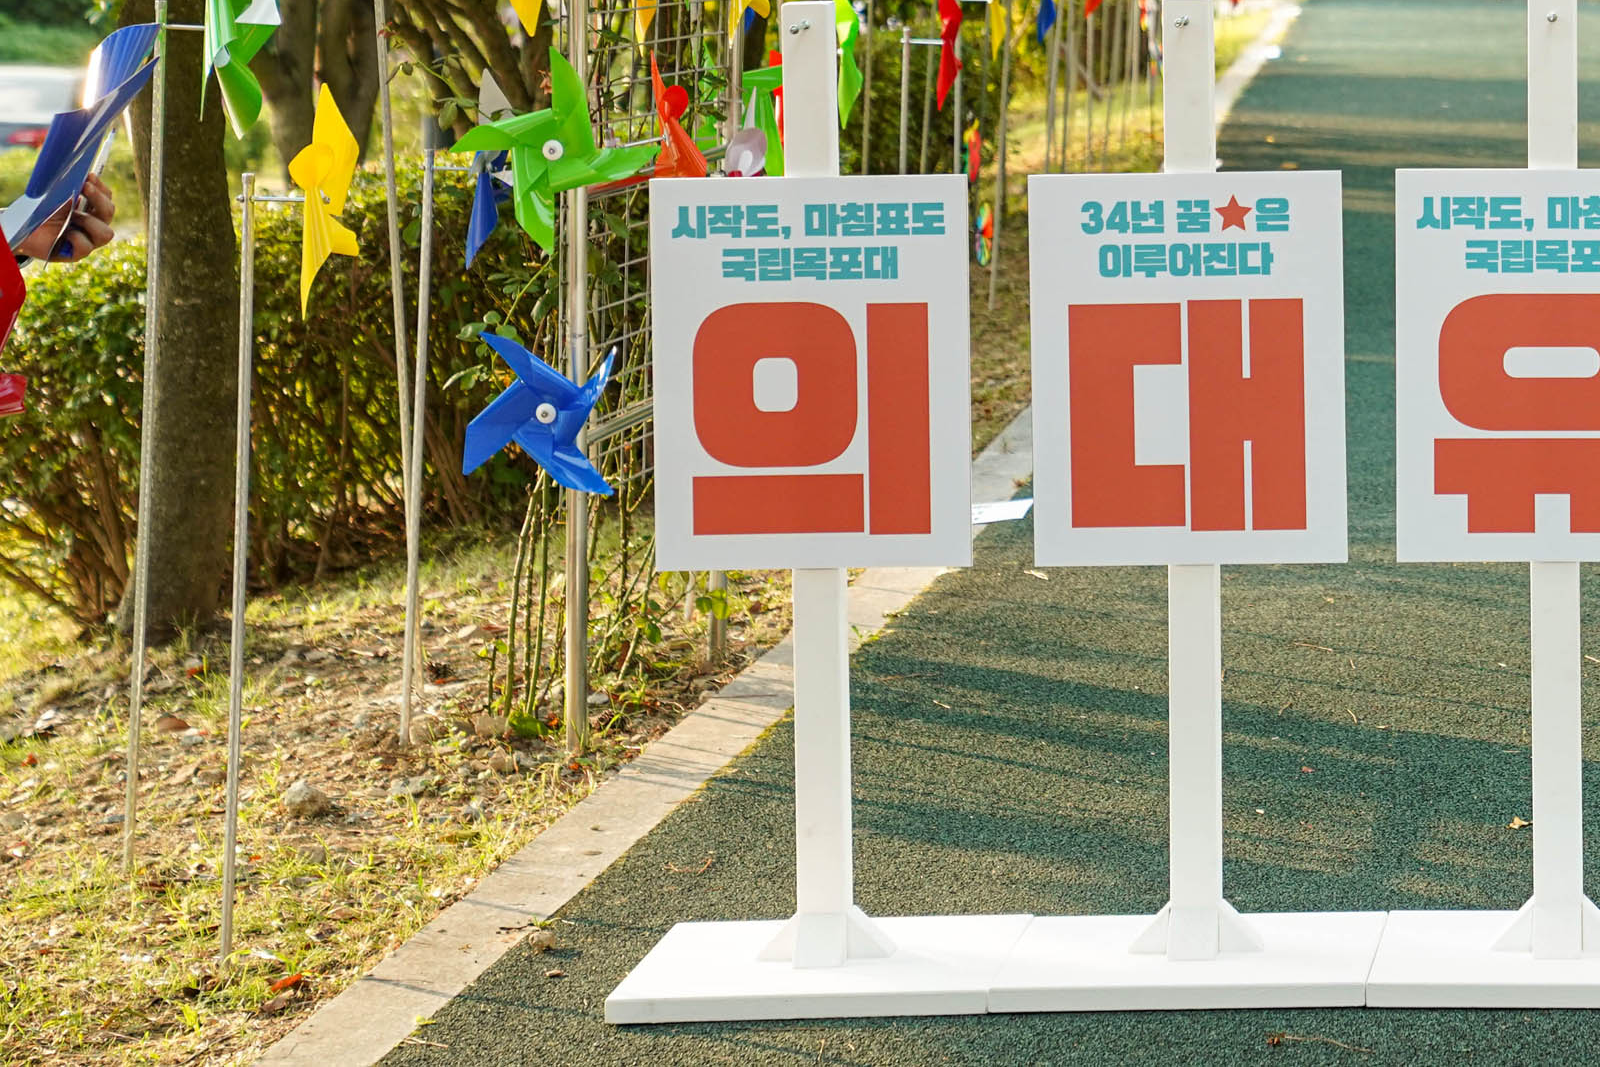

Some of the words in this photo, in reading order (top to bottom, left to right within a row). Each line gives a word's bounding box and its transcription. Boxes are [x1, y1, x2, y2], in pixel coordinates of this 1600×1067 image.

[672, 205, 791, 239] 시작도,
[805, 202, 944, 236] 마침표도
[1081, 200, 1164, 234] 34년
[1416, 197, 1534, 231] 시작도,
[722, 246, 898, 281] 국립목포대
[1099, 242, 1273, 278] 이루어진다
[693, 302, 931, 534] 의
[1069, 299, 1306, 531] 대
